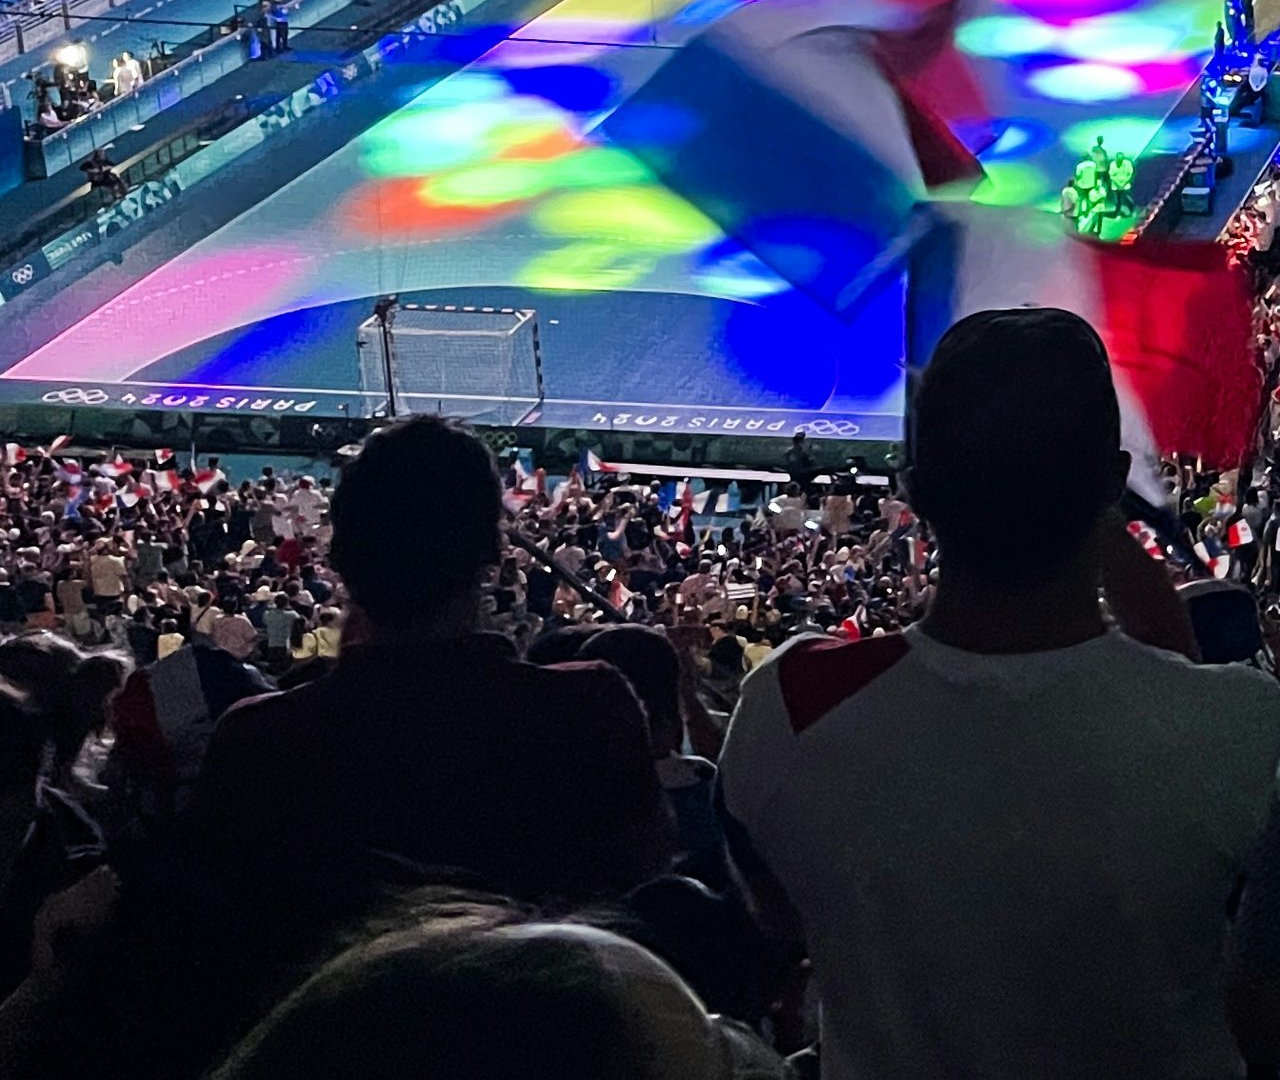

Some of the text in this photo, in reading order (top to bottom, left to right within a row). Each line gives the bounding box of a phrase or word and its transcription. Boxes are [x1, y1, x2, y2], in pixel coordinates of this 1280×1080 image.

[120, 392, 318, 412] PARIS 2024
[592, 412, 786, 431] PARIS 2024
